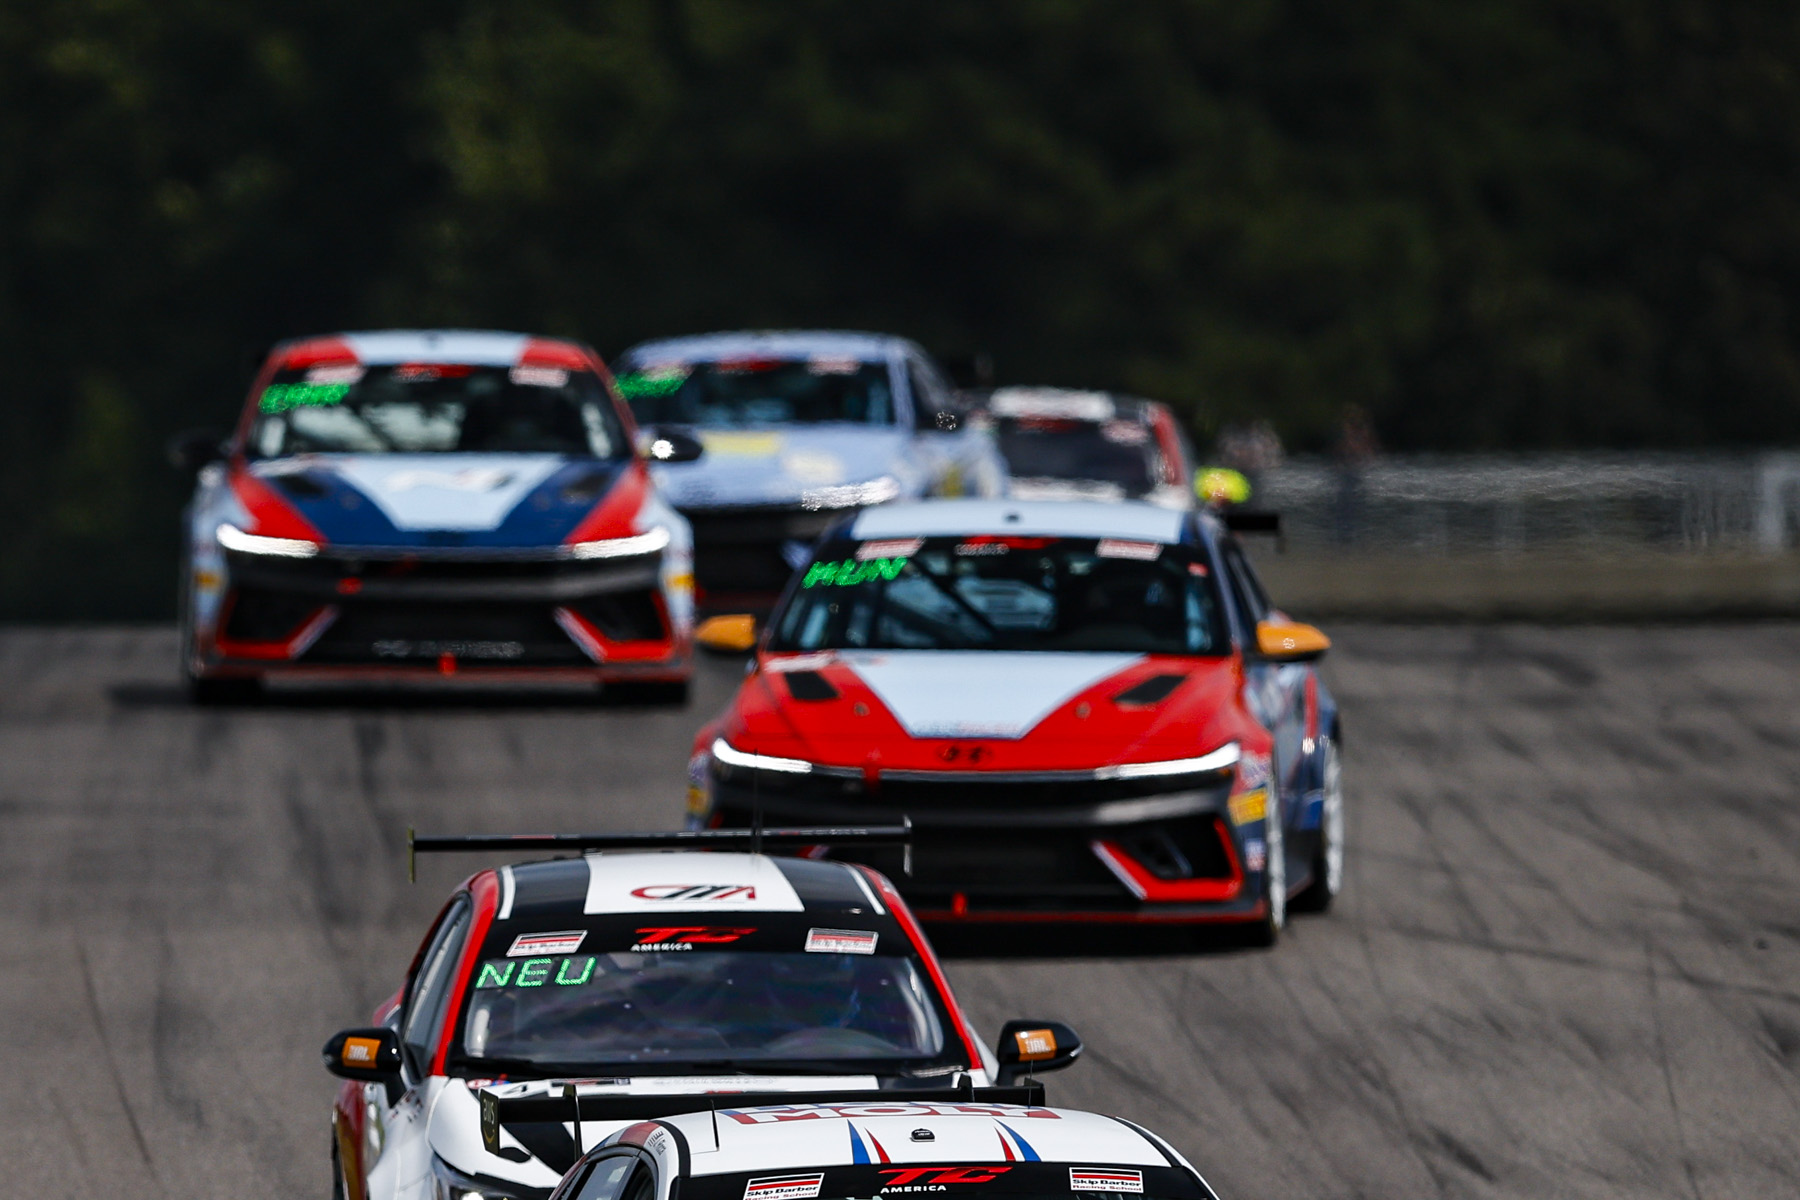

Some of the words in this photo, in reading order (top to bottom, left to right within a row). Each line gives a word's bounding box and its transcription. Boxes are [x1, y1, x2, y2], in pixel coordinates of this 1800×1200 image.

[630, 942, 693, 952] AMERICA
[476, 956, 597, 988] NEU
[746, 1105, 1045, 1122] MOLY
[878, 1167, 1013, 1186] TC
[746, 1189, 774, 1197] Skip
[775, 1185, 819, 1194] Barber
[880, 1185, 947, 1194] AMERICA
